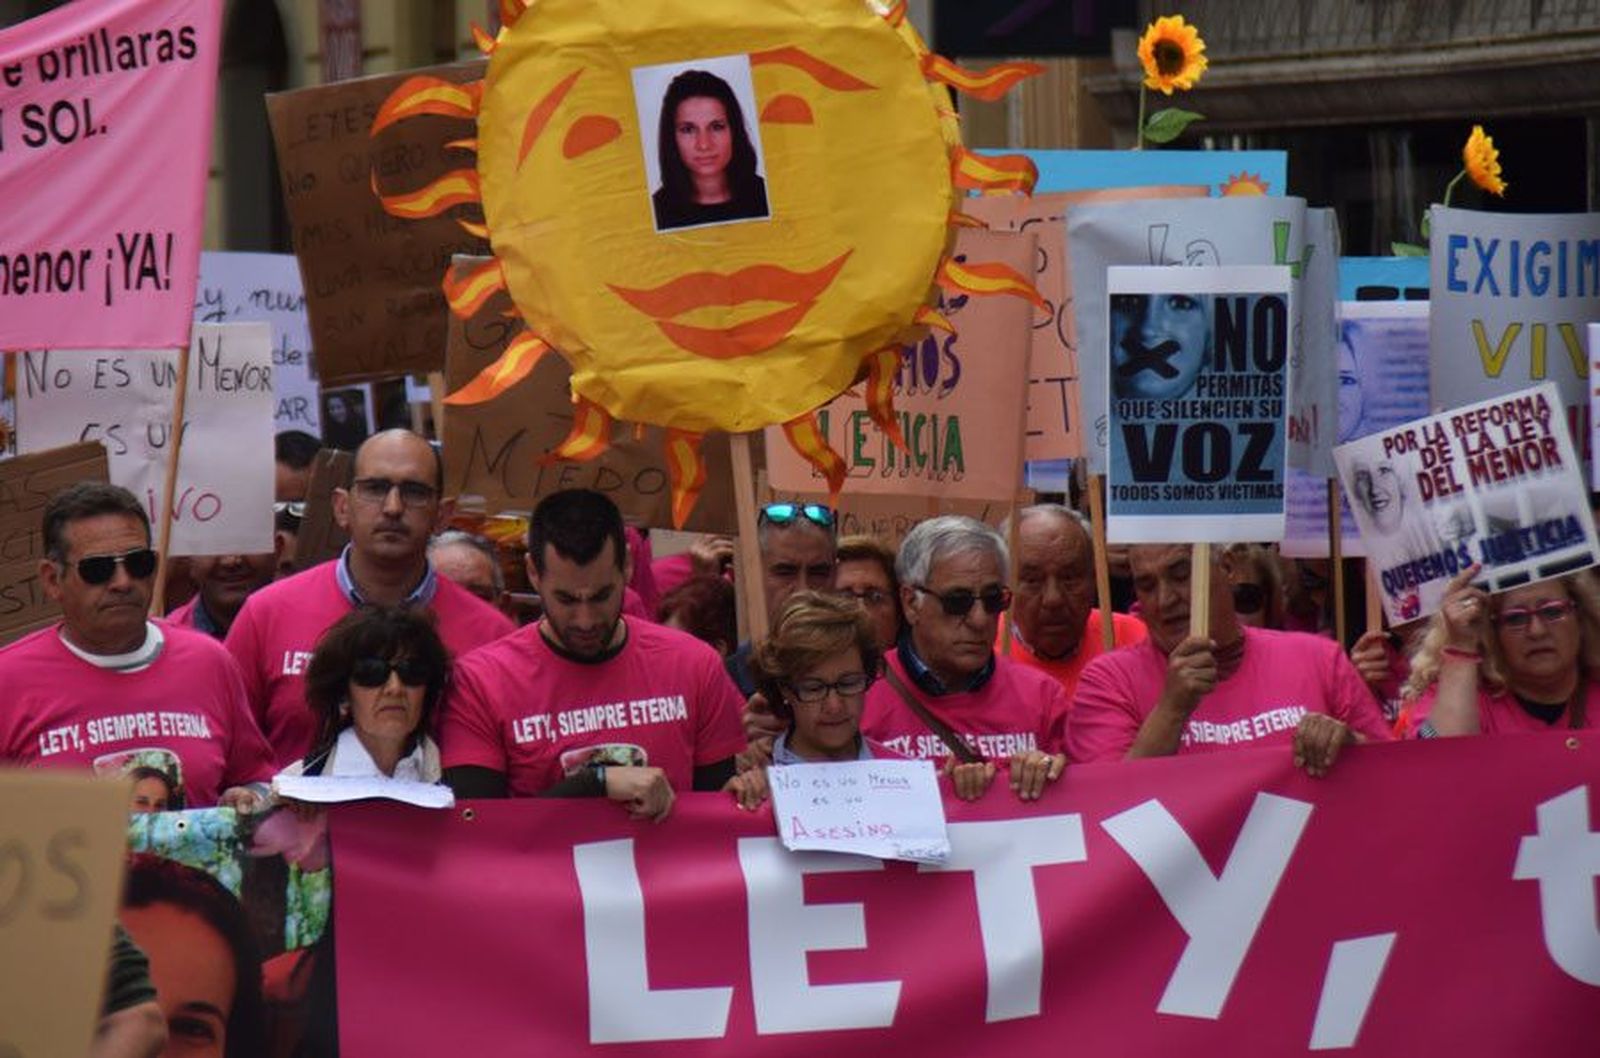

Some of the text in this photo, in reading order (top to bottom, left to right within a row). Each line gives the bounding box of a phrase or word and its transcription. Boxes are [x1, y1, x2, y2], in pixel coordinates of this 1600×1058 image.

[38, 25, 196, 83] brillaras
[21, 97, 107, 148] SOL.
[105, 232, 173, 305] ¡YA!
[1213, 296, 1288, 374] NO
[94, 359, 130, 388] ES
[1197, 374, 1283, 398] PERMITAS
[1118, 400, 1283, 420] QUE SILENCIEN SU
[1382, 429, 1418, 459] POR
[1422, 420, 1450, 447] LA
[1452, 392, 1552, 438] REFORMA
[810, 411, 966, 482] LETICIA
[1120, 421, 1277, 484] VOZ
[1416, 464, 1463, 503] DEL
[1466, 436, 1562, 490] MENOR
[1420, 444, 1454, 470] DE
[1458, 430, 1497, 459] LA
[1503, 414, 1552, 446] LEY
[1111, 484, 1285, 502] TODOS SOMOS VICTIMAS
[1380, 540, 1475, 597] QUEREMOS
[38, 711, 211, 757] LETY, SIEMPRE ETERNA
[512, 694, 688, 745] LETY, SIEMPRE ETERNA
[977, 732, 1036, 758] ETERNA
[1189, 719, 1254, 745] SIEMPRE
[573, 791, 1398, 1051] LETY,
